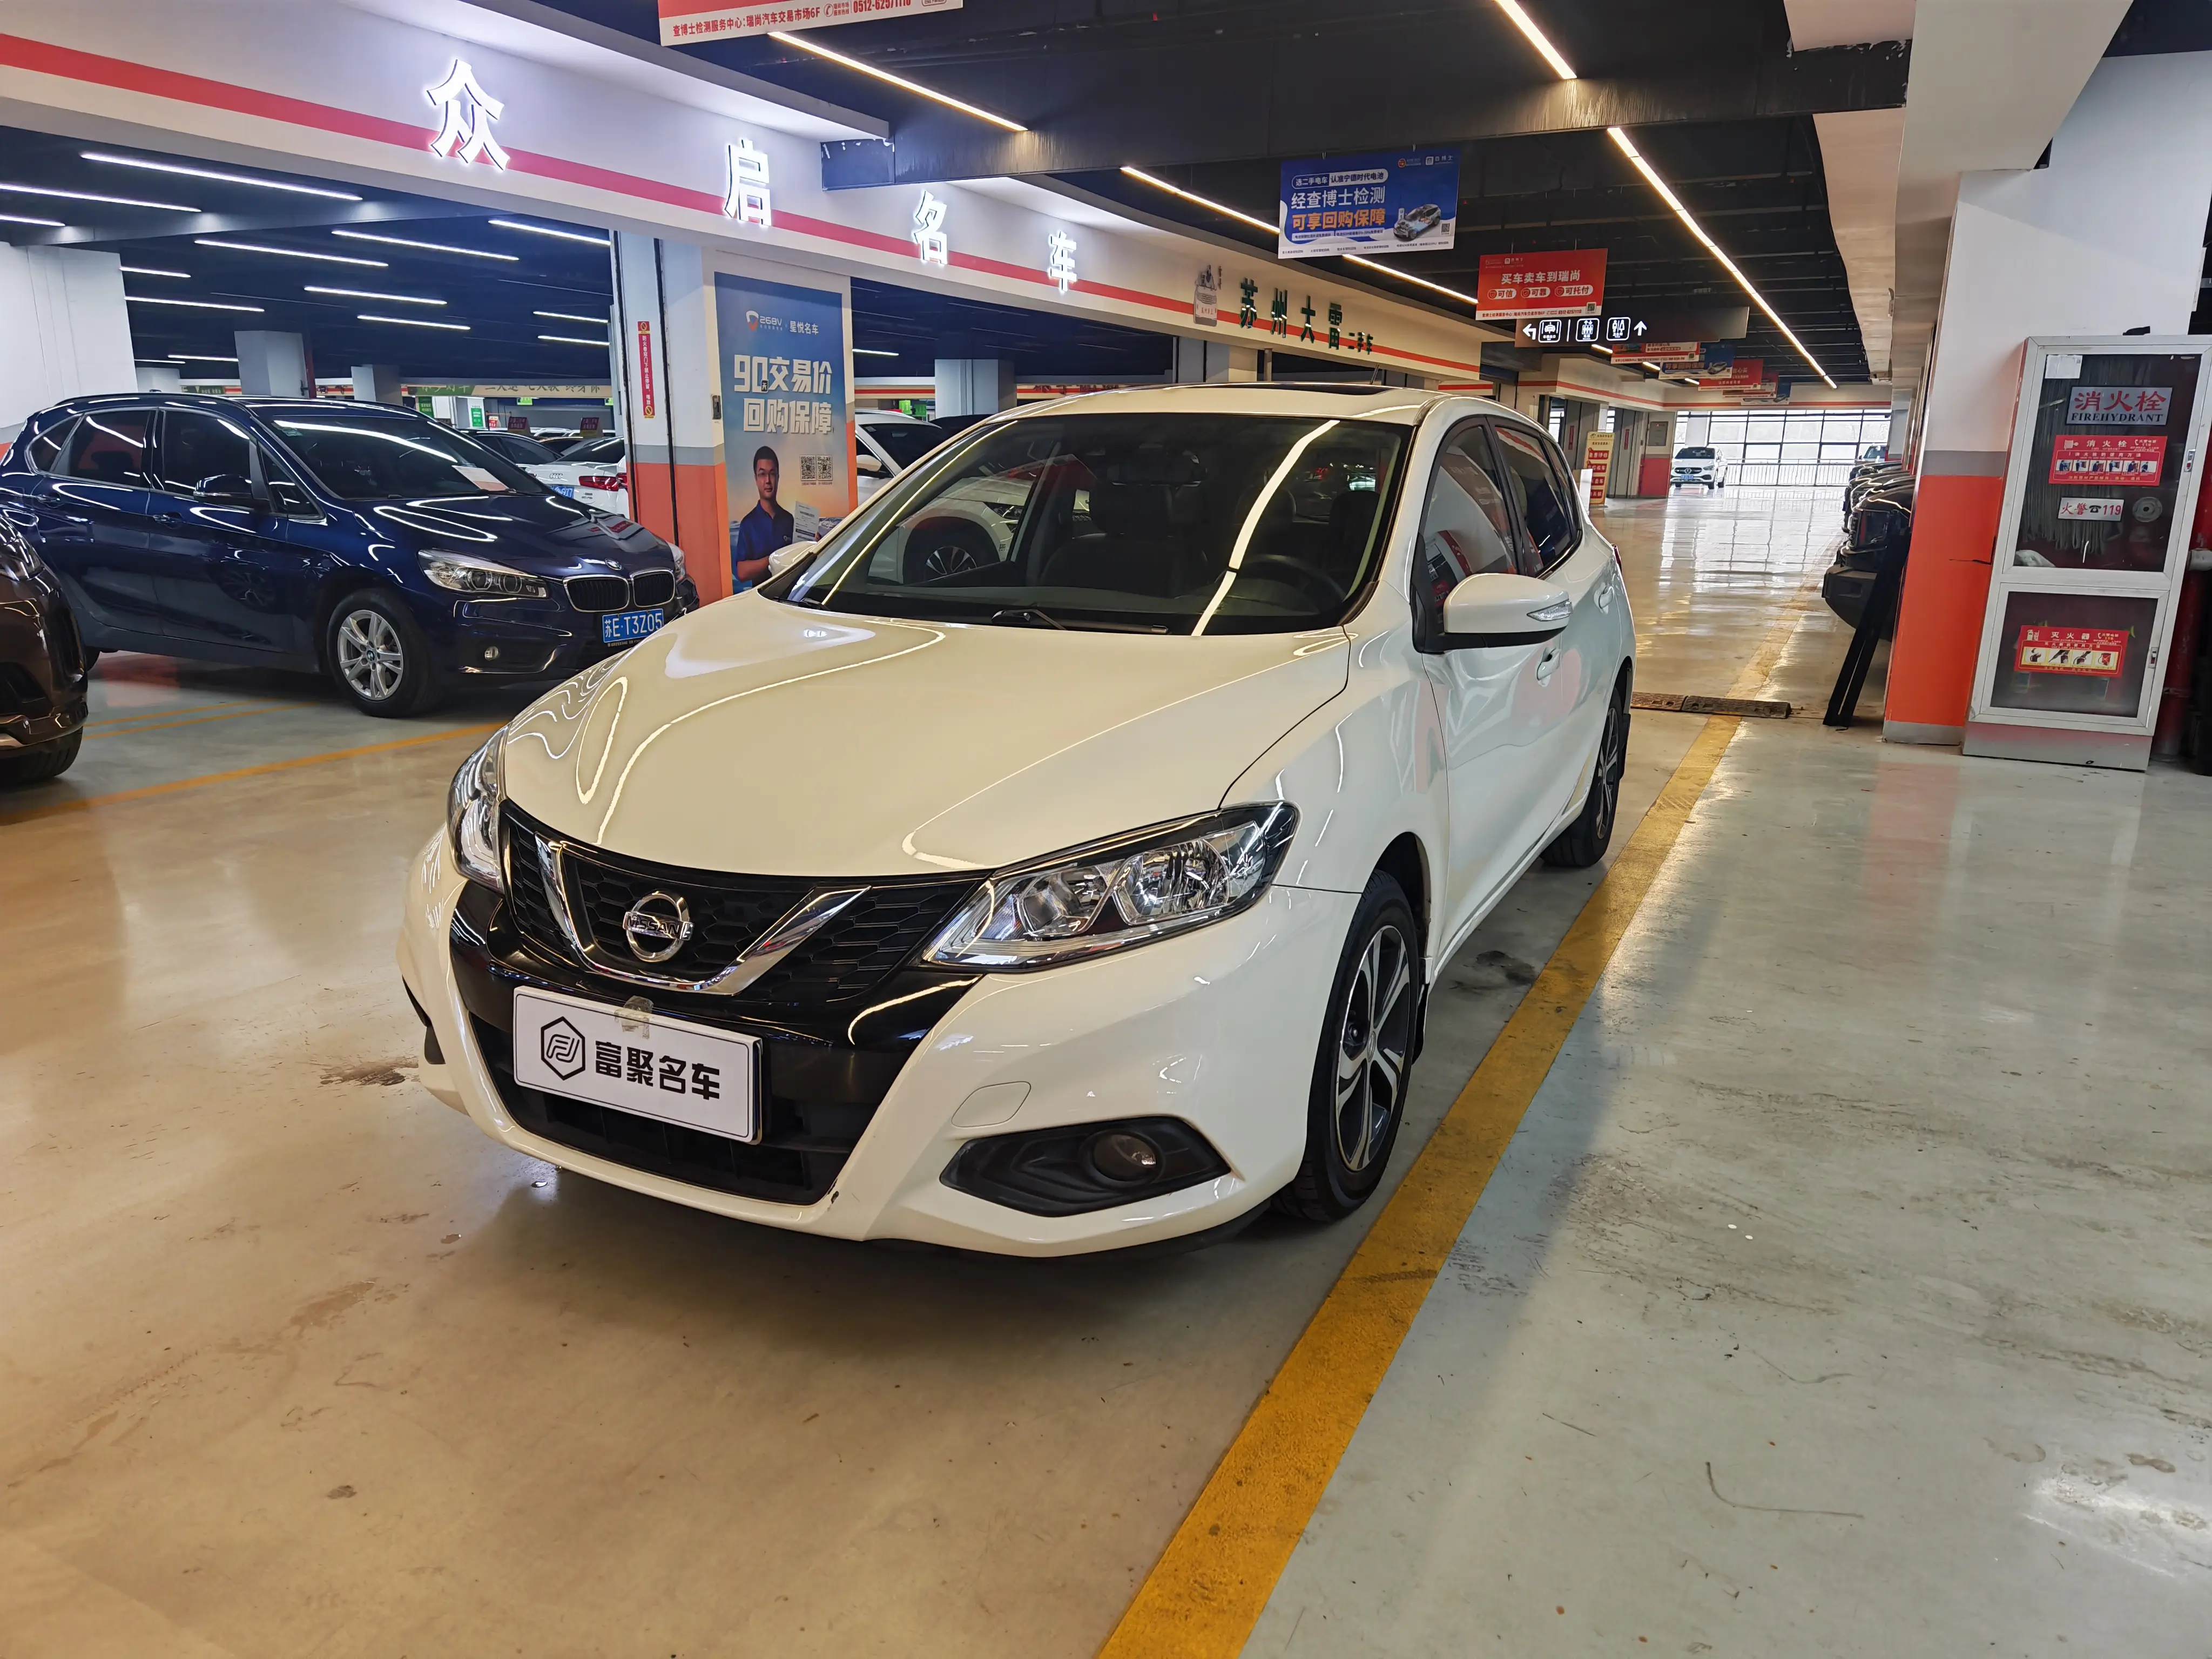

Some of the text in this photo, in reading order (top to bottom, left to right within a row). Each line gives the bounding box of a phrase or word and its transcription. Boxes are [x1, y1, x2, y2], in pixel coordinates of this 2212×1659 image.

[1296, 171, 1384, 186] 选二手电车 认准宁德时代电池
[1291, 185, 1386, 210] 经查博士检测
[1292, 208, 1386, 231] 可享回购保障
[1501, 269, 1580, 285] 买车卖车到瑞尚
[1498, 286, 1589, 298] 可信 可靠 可托付
[760, 315, 782, 326] 268V
[790, 320, 819, 335] 星悦名车
[2074, 390, 2167, 412] 消火栓
[744, 397, 832, 434] 回购保障
[2071, 413, 2163, 422] FIREHYDRANT
[2086, 440, 2127, 448] 消火栓
[2060, 502, 2121, 515] 火警 119
[627, 915, 681, 936] NISSAN
[595, 1040, 720, 1100] 富聚名车
